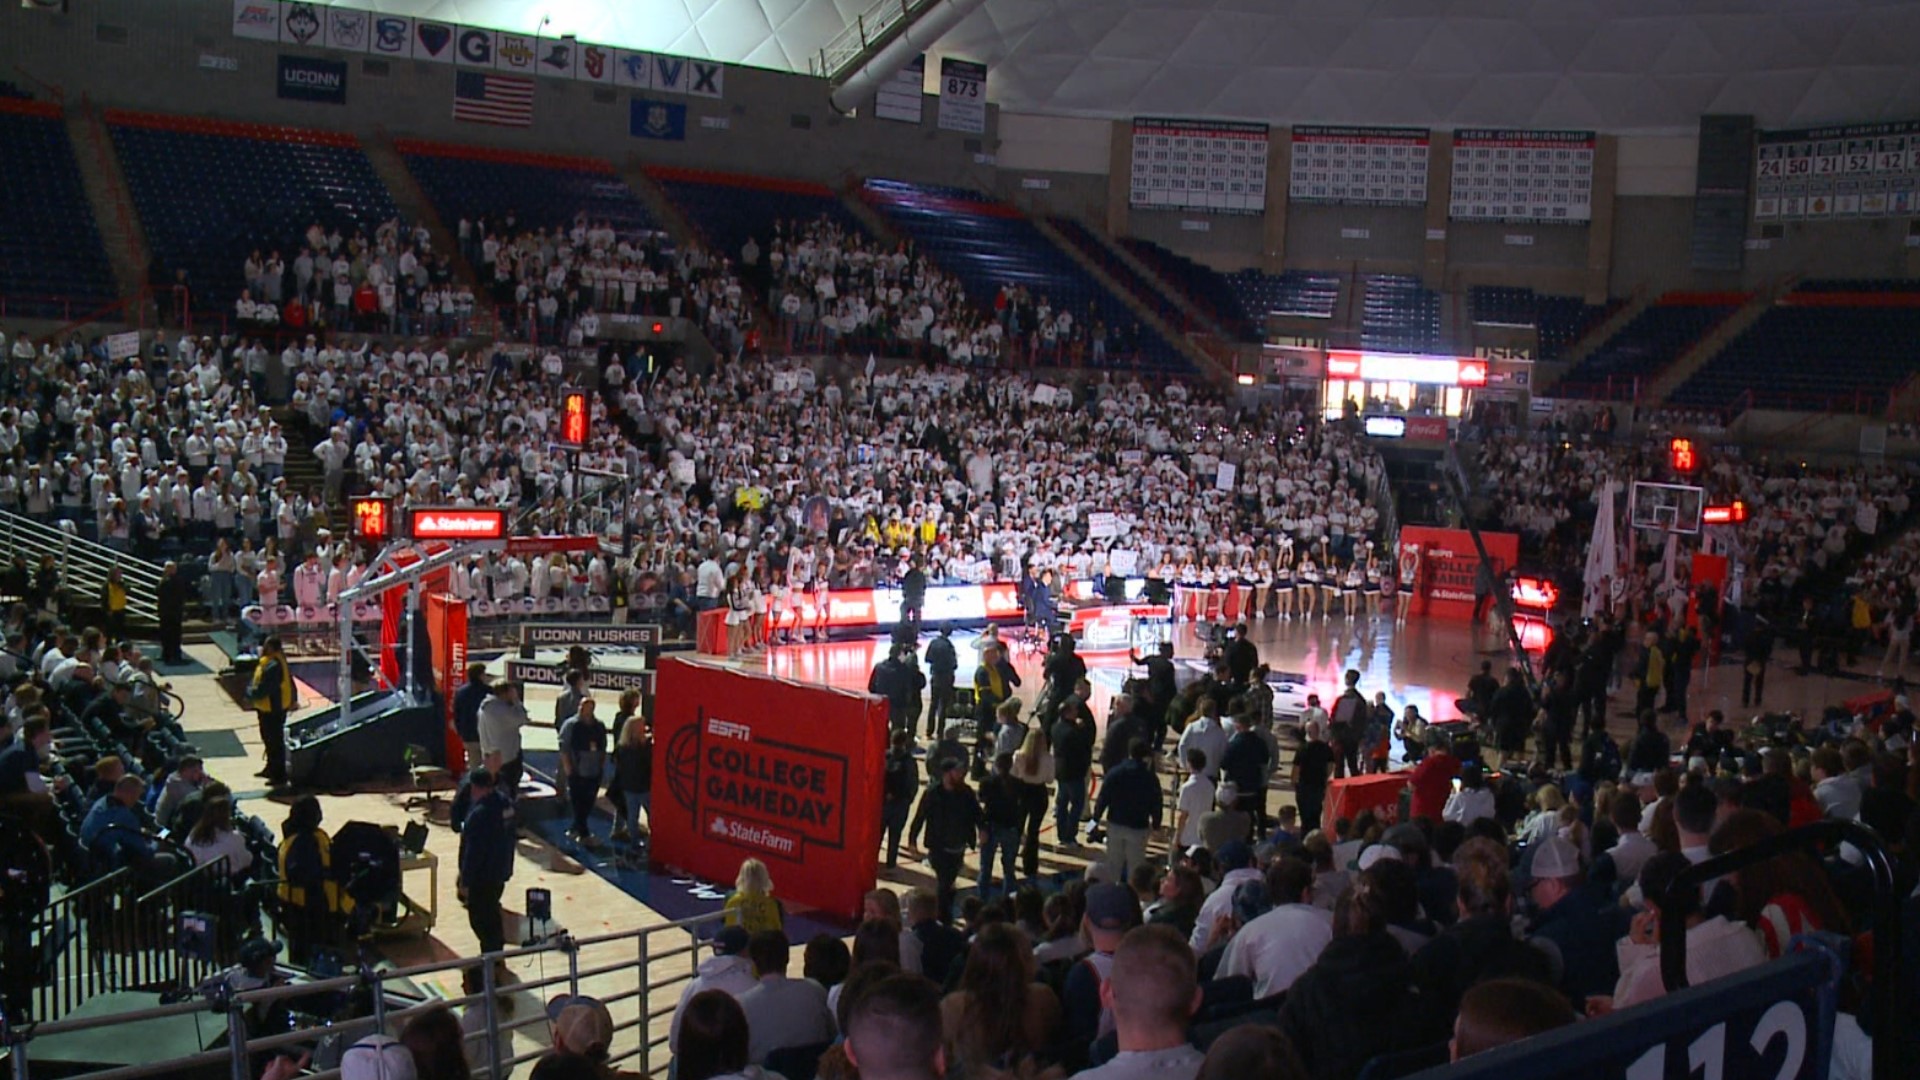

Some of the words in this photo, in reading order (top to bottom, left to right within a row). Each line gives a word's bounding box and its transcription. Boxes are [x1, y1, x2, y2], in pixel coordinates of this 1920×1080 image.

[459, 30, 491, 62] G
[284, 67, 340, 88] UCONN
[693, 63, 718, 94] X
[948, 78, 978, 98] 873
[1761, 160, 1779, 175] 24
[1789, 159, 1808, 174] 50
[1822, 157, 1836, 172] 21
[1850, 156, 1868, 170] 52
[1880, 153, 1901, 168] 42
[365, 517, 379, 534] 19
[1431, 561, 1474, 574] COLLE
[1431, 573, 1475, 586] GAME
[532, 629, 581, 641] UCONN
[588, 630, 650, 642] HUSKIES
[516, 666, 561, 682] UCON
[590, 672, 642, 689] USKIES
[708, 719, 750, 741] ESPN
[707, 746, 827, 795] COLLEGE
[705, 777, 834, 827] GAMEDAY
